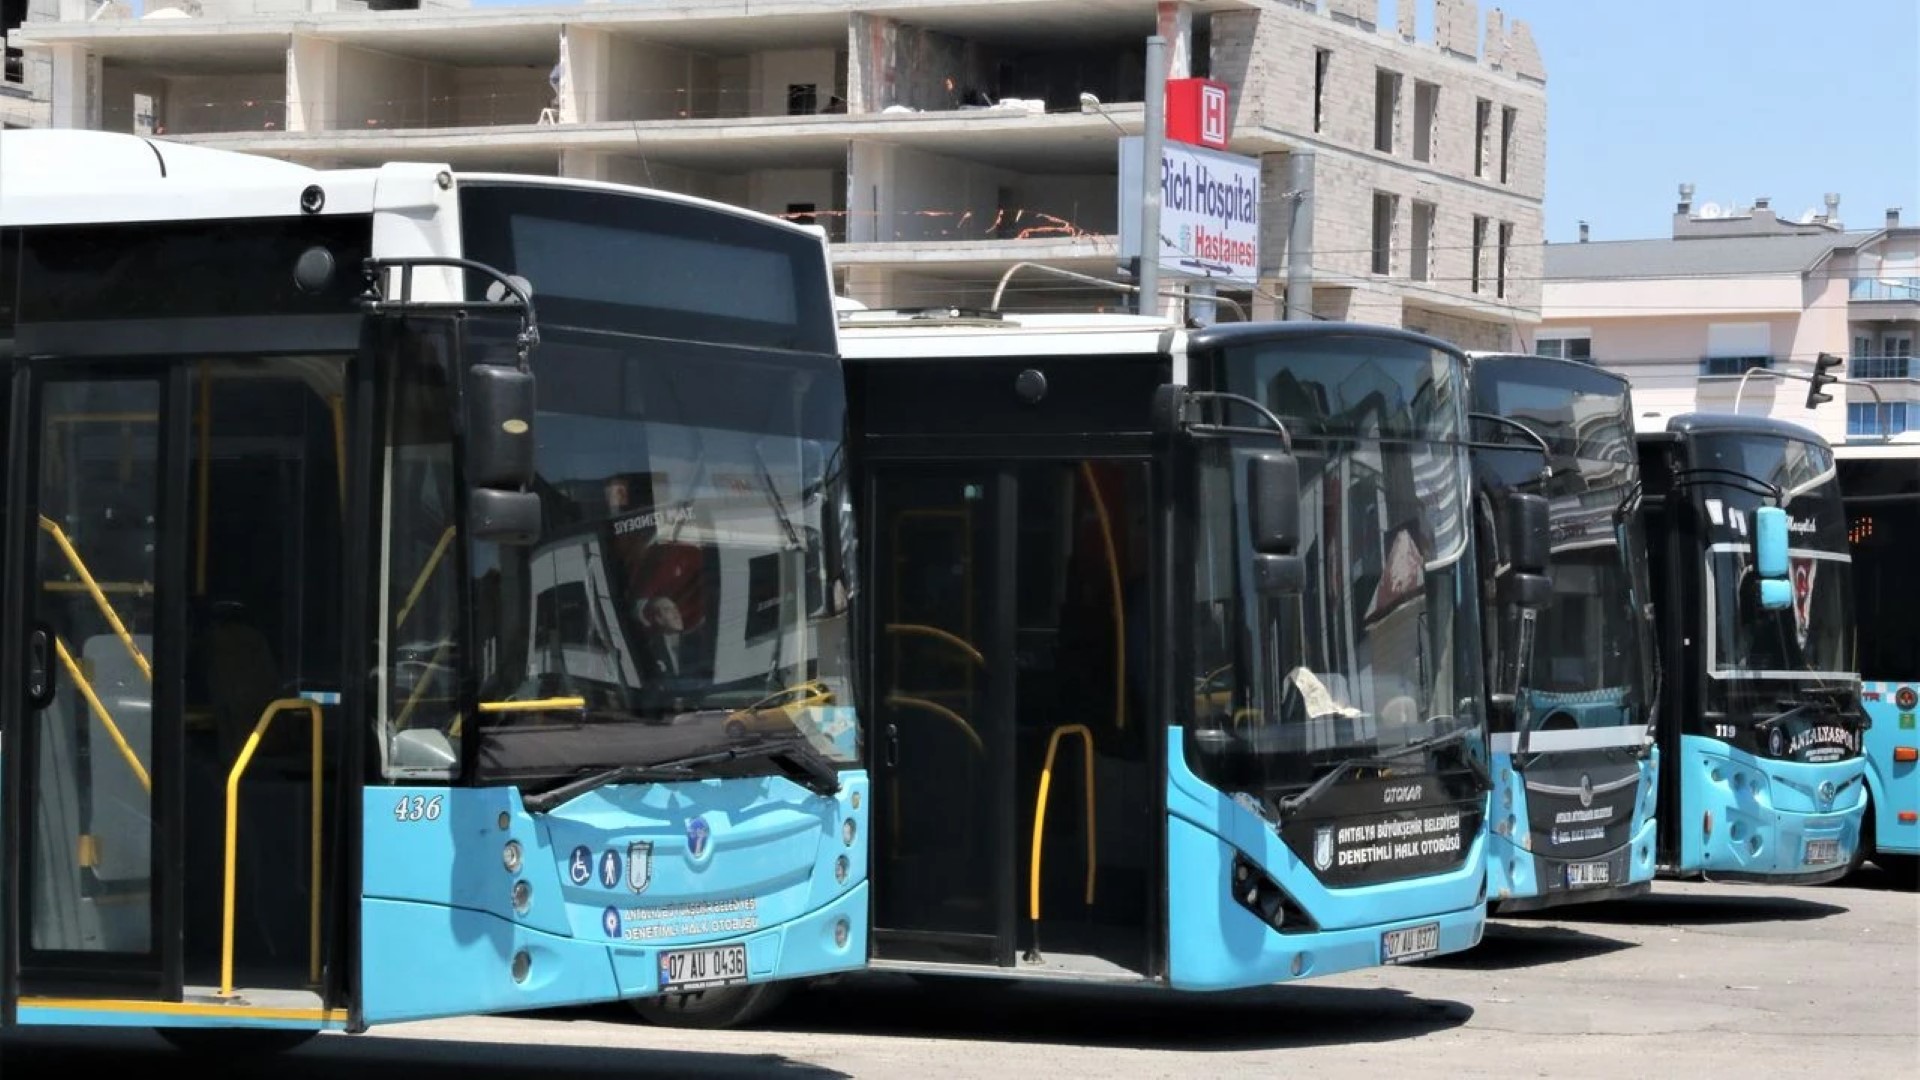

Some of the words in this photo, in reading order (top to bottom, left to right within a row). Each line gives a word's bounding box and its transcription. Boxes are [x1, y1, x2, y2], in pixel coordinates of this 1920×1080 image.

[1162, 157, 1192, 212] Rich
[1196, 164, 1256, 229] Hospital
[1195, 225, 1256, 267] Hastanesi
[1715, 724, 1736, 738] 119
[1789, 725, 1852, 754] ANTALYASPOR
[395, 794, 444, 821] 436
[1384, 786, 1422, 803] OTOKAR
[1338, 824, 1375, 844] ANTALYA
[1338, 843, 1393, 866] DENETİMLİ
[1394, 843, 1420, 859] HALK
[1421, 834, 1461, 854] OTOBÜSÜ
[682, 921, 709, 935] HALK
[669, 953, 685, 979] 07
[691, 951, 706, 978] AU
[713, 948, 743, 975] 0436
